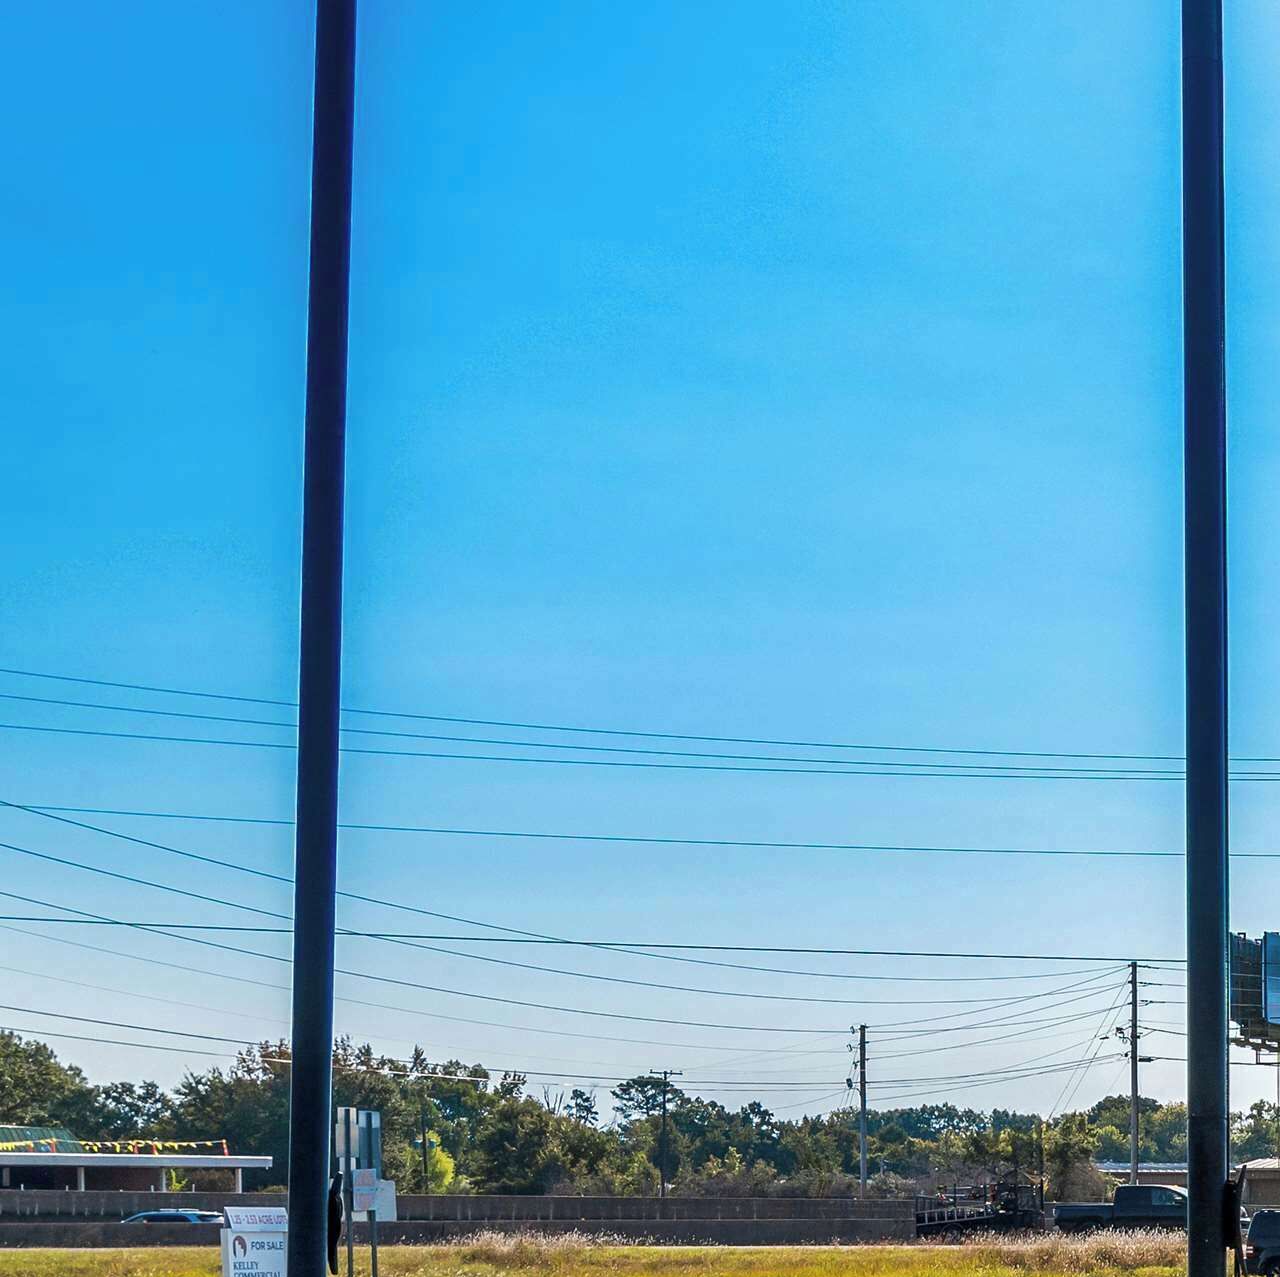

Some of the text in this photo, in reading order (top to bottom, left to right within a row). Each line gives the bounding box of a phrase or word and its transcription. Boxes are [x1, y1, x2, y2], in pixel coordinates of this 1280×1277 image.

[251, 1241, 284, 1250] FOR SALE
[233, 1261, 258, 1270] KELLEY
